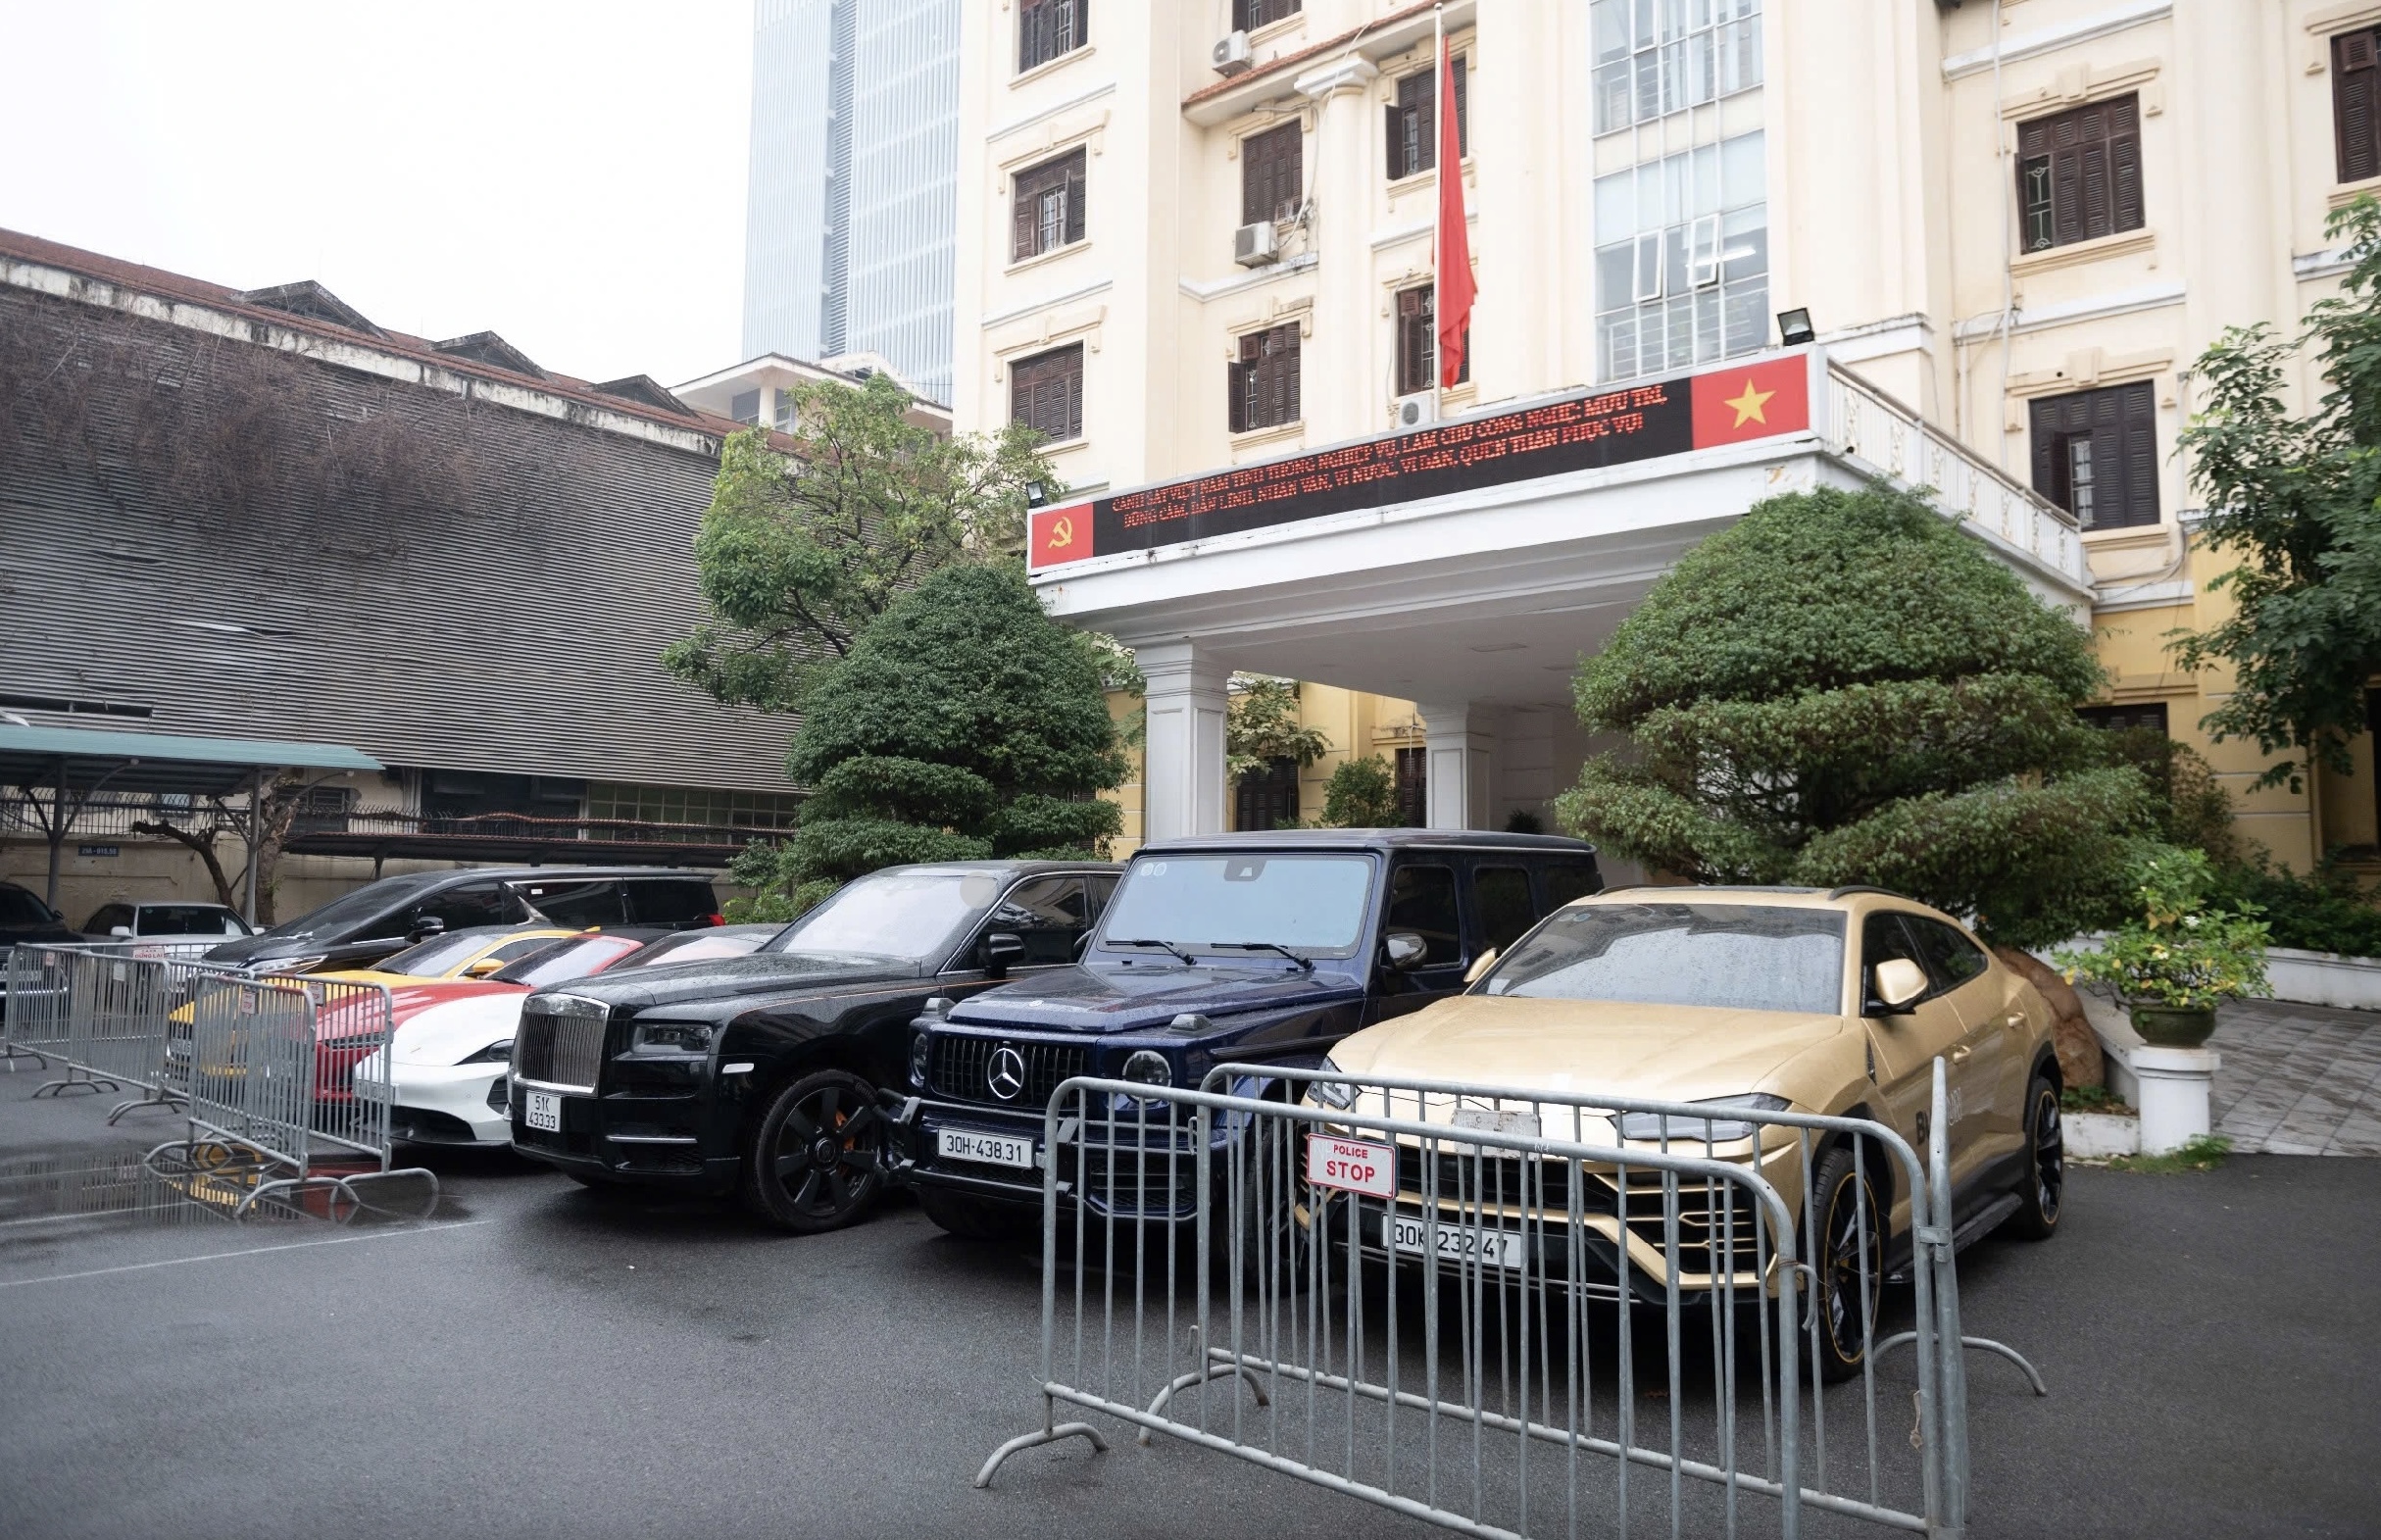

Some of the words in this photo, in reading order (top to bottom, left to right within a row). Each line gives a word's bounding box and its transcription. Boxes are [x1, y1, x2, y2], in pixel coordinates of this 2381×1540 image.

[1200, 475, 1229, 495] NAM
[535, 1095, 550, 1113] 51K
[529, 1112, 556, 1129] 433.33
[1333, 1143, 1368, 1159] POLICE
[1326, 1160, 1375, 1183] STOP
